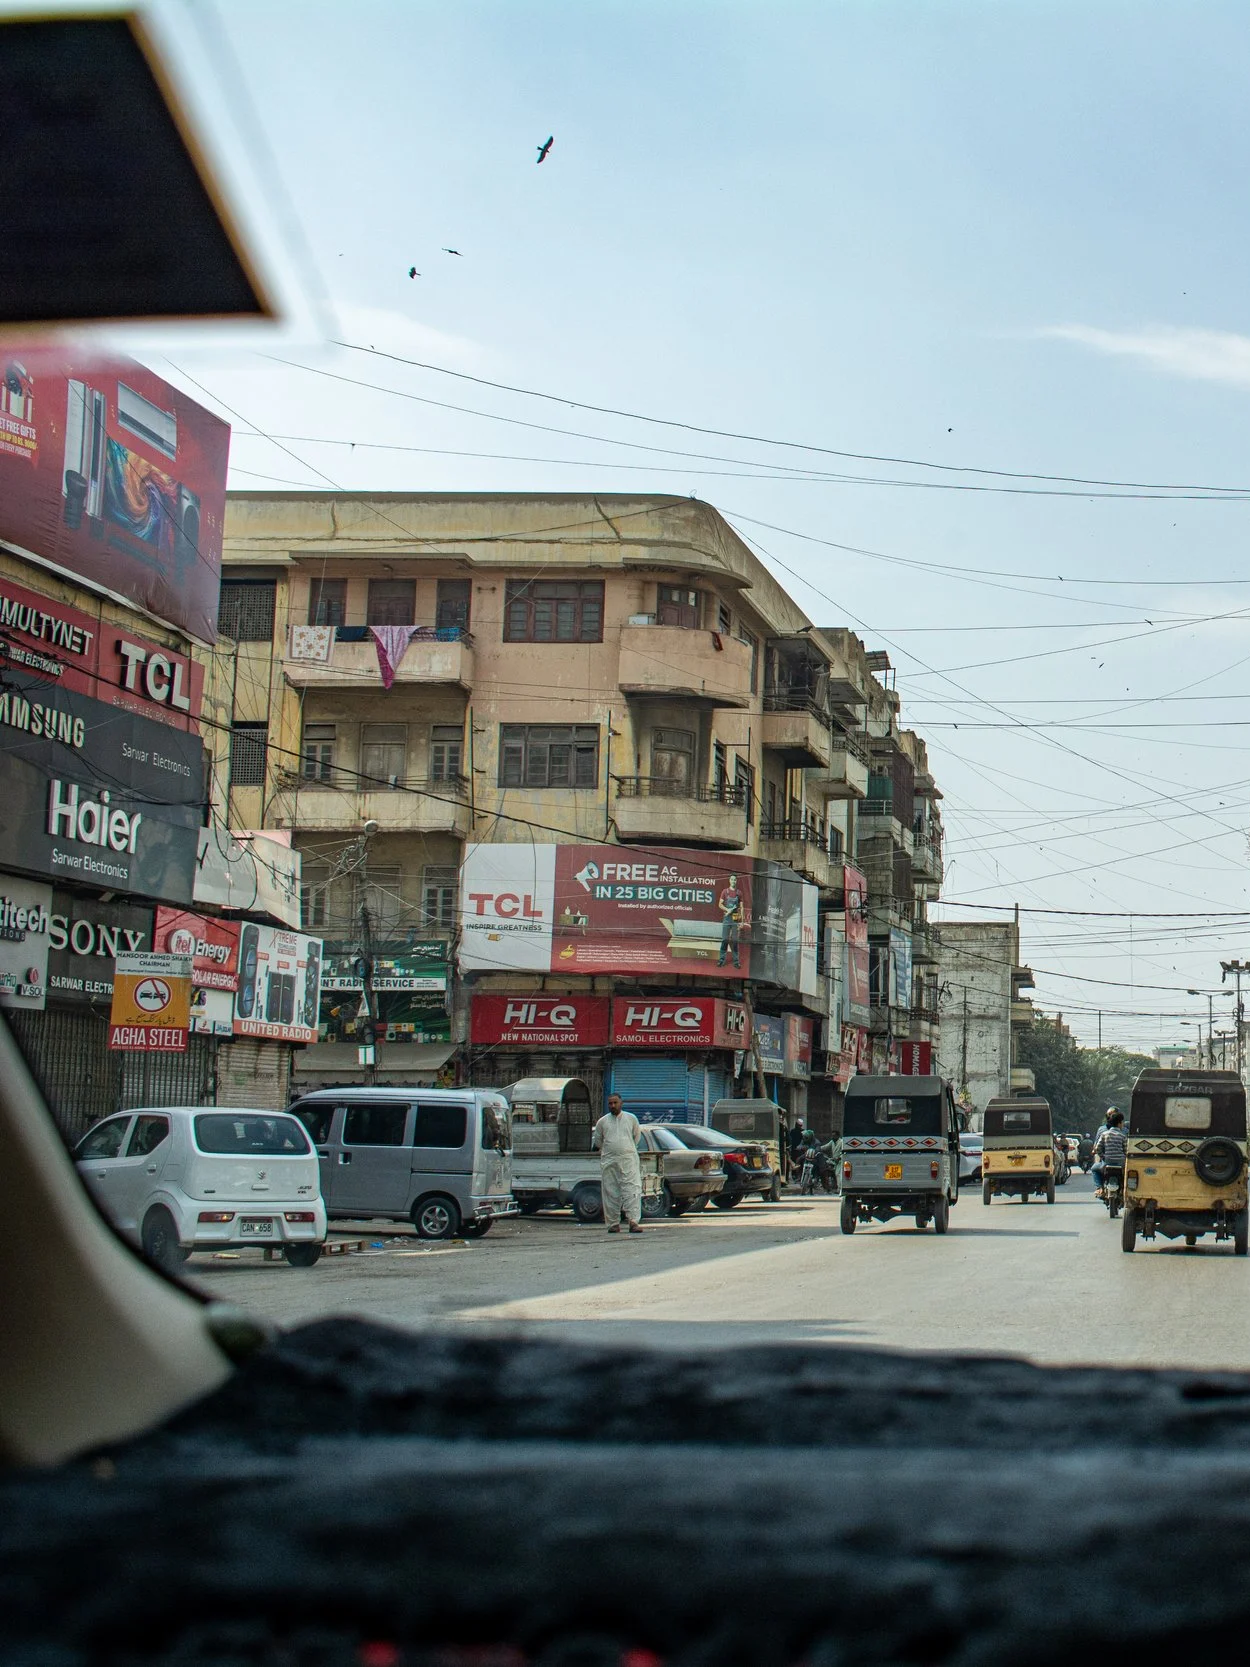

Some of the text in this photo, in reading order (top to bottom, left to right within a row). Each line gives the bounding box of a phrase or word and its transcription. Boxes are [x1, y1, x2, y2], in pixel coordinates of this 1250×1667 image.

[1, 597, 94, 656] MULTYNET
[120, 640, 191, 711] TCL
[122, 742, 191, 777] Sarwar Electronics
[48, 778, 142, 854] Haier
[52, 847, 129, 880] Sarwar Electronics
[602, 863, 678, 882] FREE AC
[660, 875, 716, 886] INSTALLATION
[595, 885, 713, 903] IN 25 BIG CITIES
[468, 892, 543, 918] TCL
[49, 914, 145, 958] SONY
[117, 952, 149, 960] MANSOOR
[175, 935, 231, 964] itel Energy
[51, 975, 114, 995] SARWAR ELECTR
[373, 979, 414, 988] SERVICE
[503, 1003, 577, 1026] HI-Q
[625, 1006, 703, 1027] HI-Q
[111, 1027, 186, 1047] AGHA STEEL
[241, 1021, 312, 1040] UNITED RADIO
[501, 1033, 579, 1042] NEW NATIONAL SPOT
[616, 1034, 711, 1043] SAMOL ELECTRONICS
[242, 1223, 272, 1233] CAN 658
